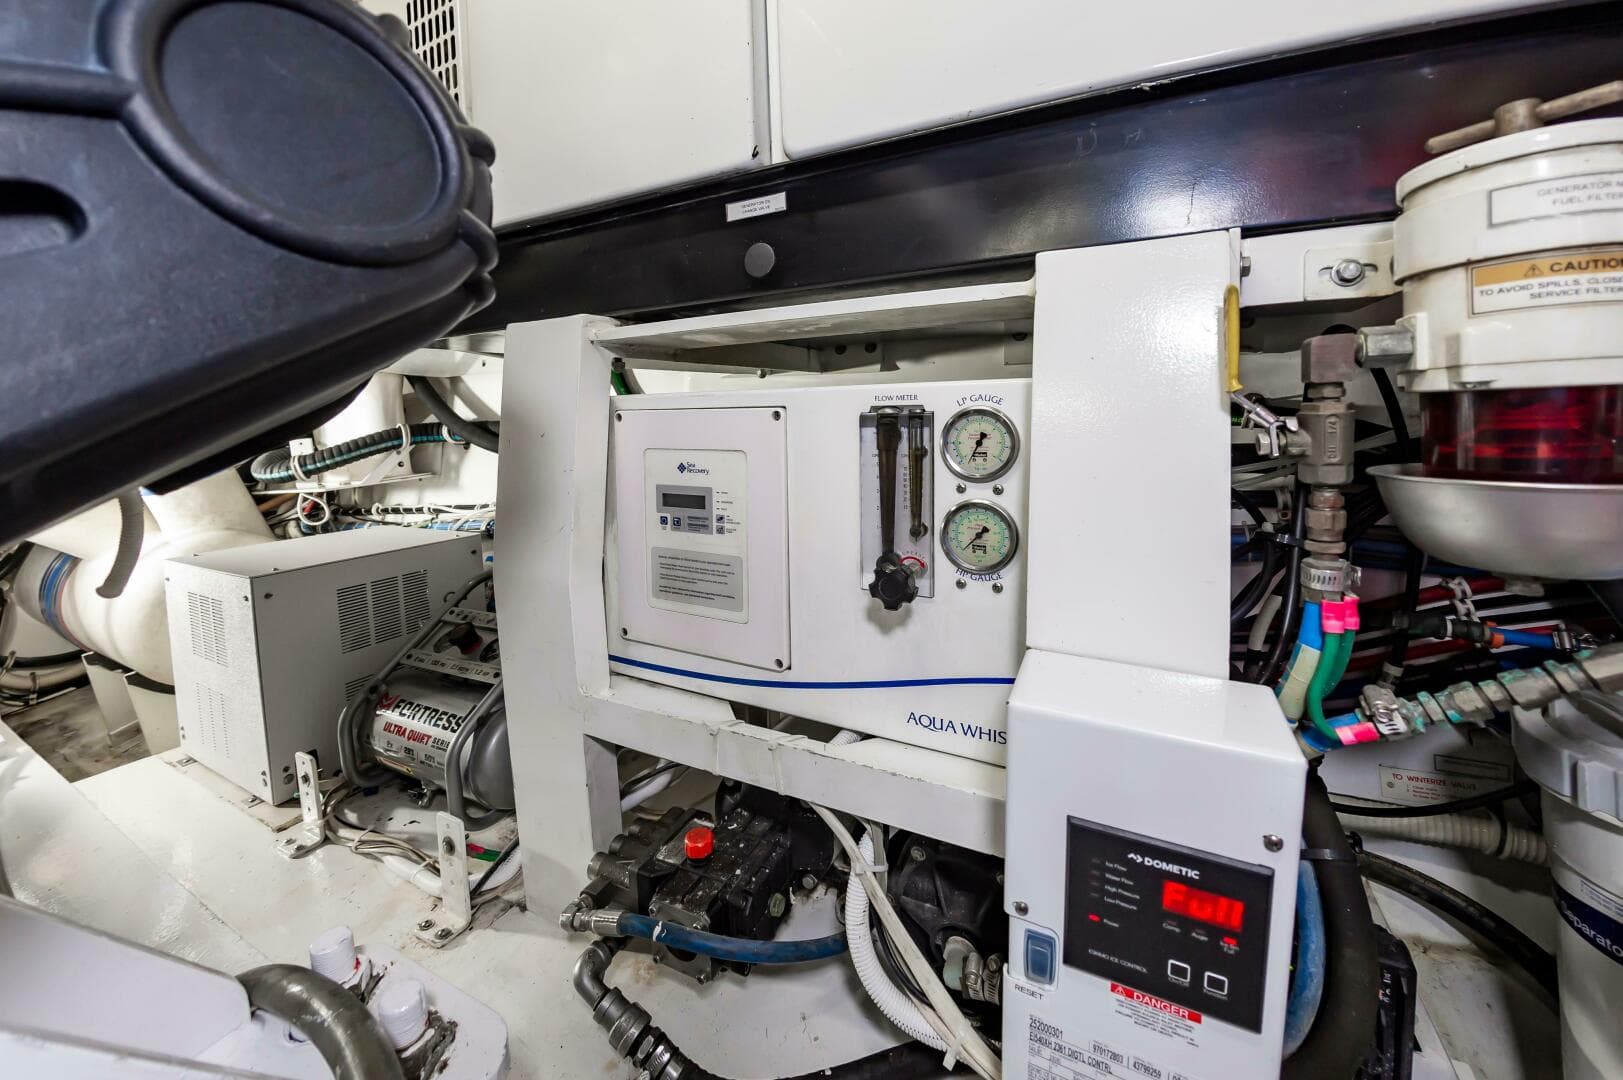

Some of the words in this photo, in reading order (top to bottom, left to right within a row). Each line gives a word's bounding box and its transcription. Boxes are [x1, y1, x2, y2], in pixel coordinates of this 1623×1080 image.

[1537, 180, 1612, 197] GENERATOR
[1552, 195, 1582, 206] FUEL
[1479, 289, 1494, 297] TO
[1497, 283, 1534, 295] AVOID
[1529, 288, 1581, 300] SERVICE
[956, 397, 967, 407] LP
[969, 393, 1004, 405] GAUGE
[686, 467, 710, 475] Recovery
[970, 571, 1004, 582] GAUGE
[391, 698, 466, 733] FORTRESS
[383, 721, 407, 739] ULTRA
[407, 729, 433, 746] QUIET
[906, 711, 958, 733] AQUA
[960, 722, 1007, 745] WHIS
[1391, 772, 1403, 781] TO
[1406, 775, 1446, 787] WINTERIZE
[1113, 863, 1127, 872] Flow
[1144, 856, 1200, 880] DOMETIC
[1117, 887, 1140, 900] Pressure
[1116, 898, 1138, 911] Pressure
[1119, 958, 1149, 974] CONTROL
[1014, 983, 1044, 1000] RESET
[1133, 991, 1190, 1019] DANGER
